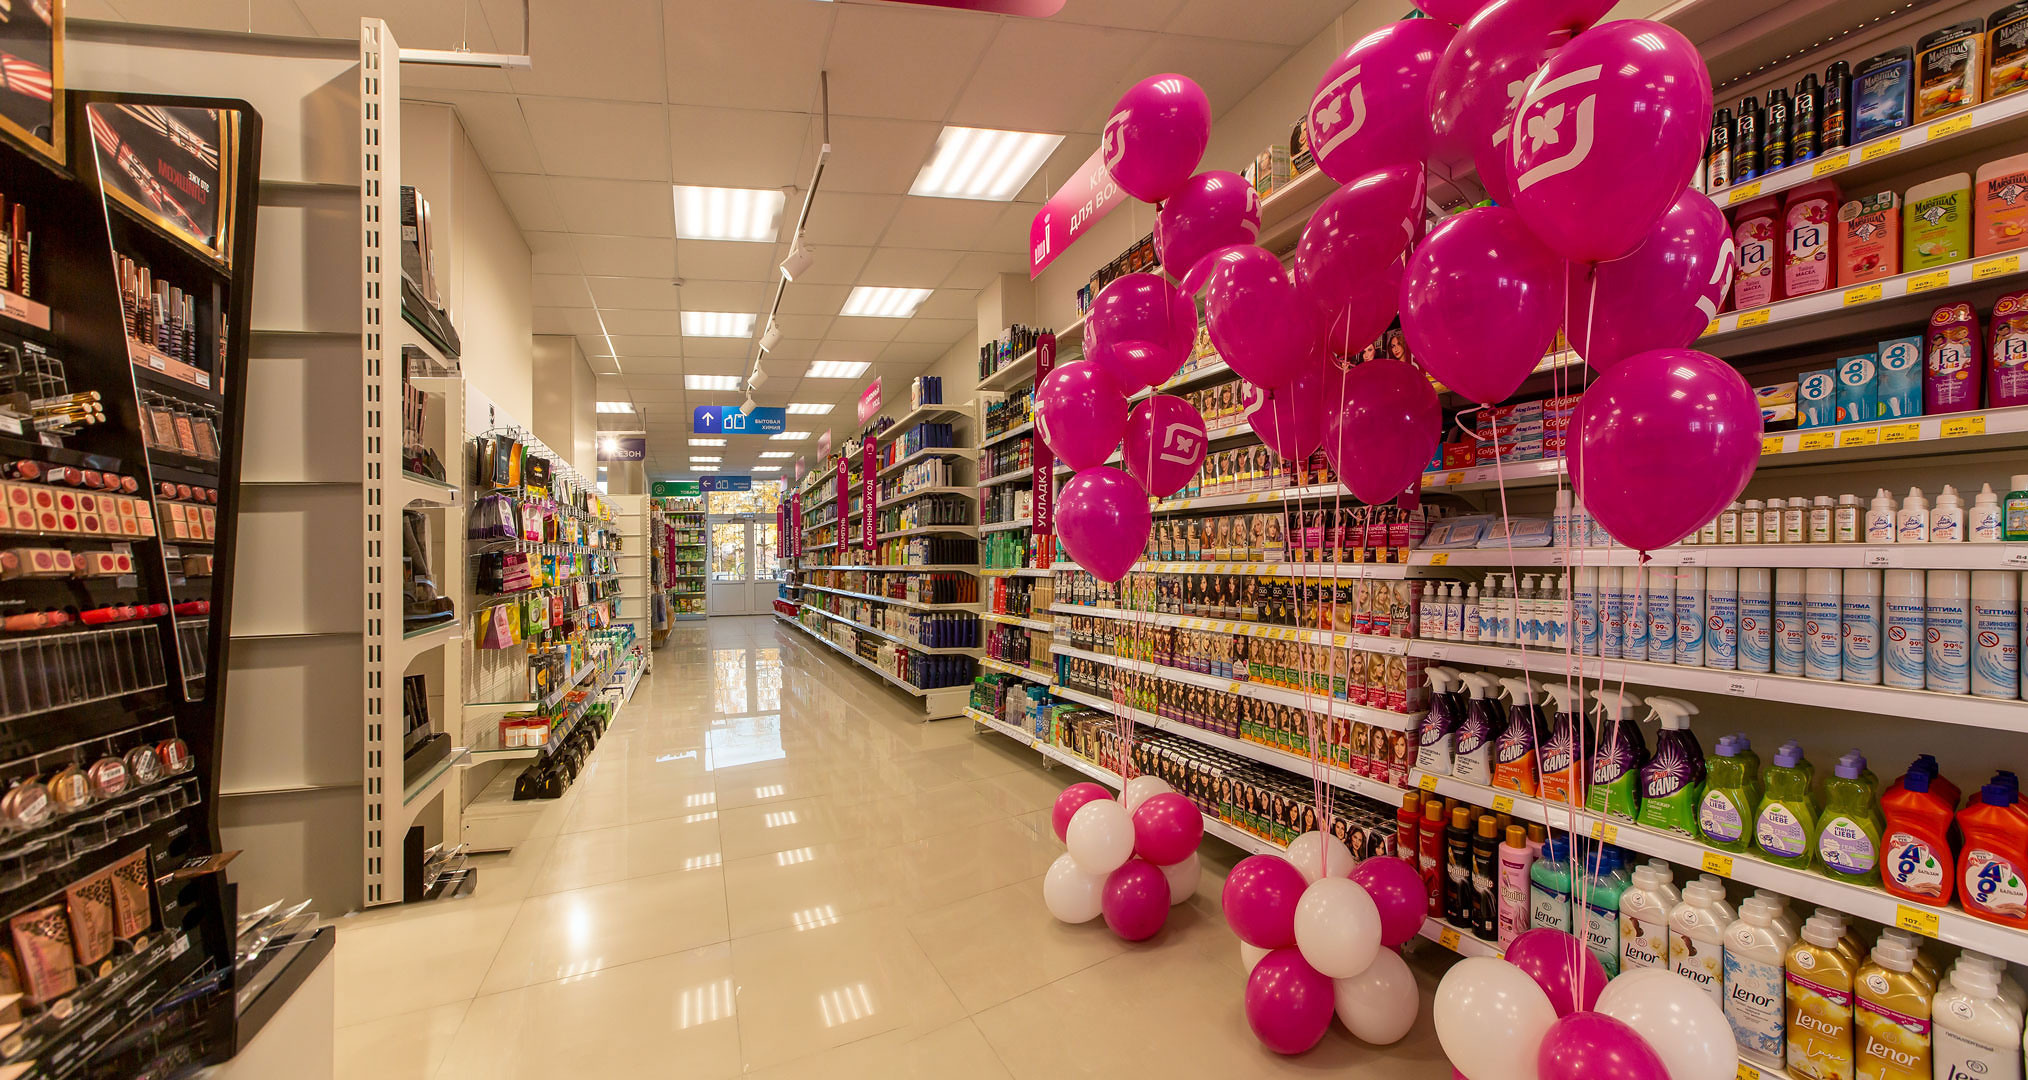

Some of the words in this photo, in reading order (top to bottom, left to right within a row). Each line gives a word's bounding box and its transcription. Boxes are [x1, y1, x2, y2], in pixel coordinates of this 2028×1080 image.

[1795, 93, 1813, 110] Fa
[1769, 104, 1787, 121] Fa
[1737, 115, 1754, 131] Fa
[1712, 126, 1728, 142] Fa
[1070, 200, 1094, 236] ДЛЯ
[1793, 226, 1820, 251] Fa
[1741, 242, 1765, 267] Fa
[2005, 338, 2027, 355] Fa
[1940, 348, 1959, 364] Fa
[1037, 466, 1048, 528] УКЛАДКА
[1978, 620, 2017, 628] ДЕЗИНФЕКТО
[1459, 736, 1479, 753] BANG
[1500, 744, 1523, 762] BANG
[1543, 754, 1570, 772] BANG
[1595, 763, 1620, 783] BANG
[1648, 776, 1680, 796] BANG
[1709, 802, 1727, 810] LIEBE
[1769, 815, 1789, 824] LIEBE
[1834, 830, 1857, 839] LIEBE
[1535, 907, 1562, 926] Lenor
[1585, 929, 1611, 945] enor
[1625, 943, 1660, 964] Lenor
[1732, 983, 1775, 1008] Lenor
[1795, 1008, 1844, 1036] Lenor
[1866, 1036, 1920, 1067] Lenor
